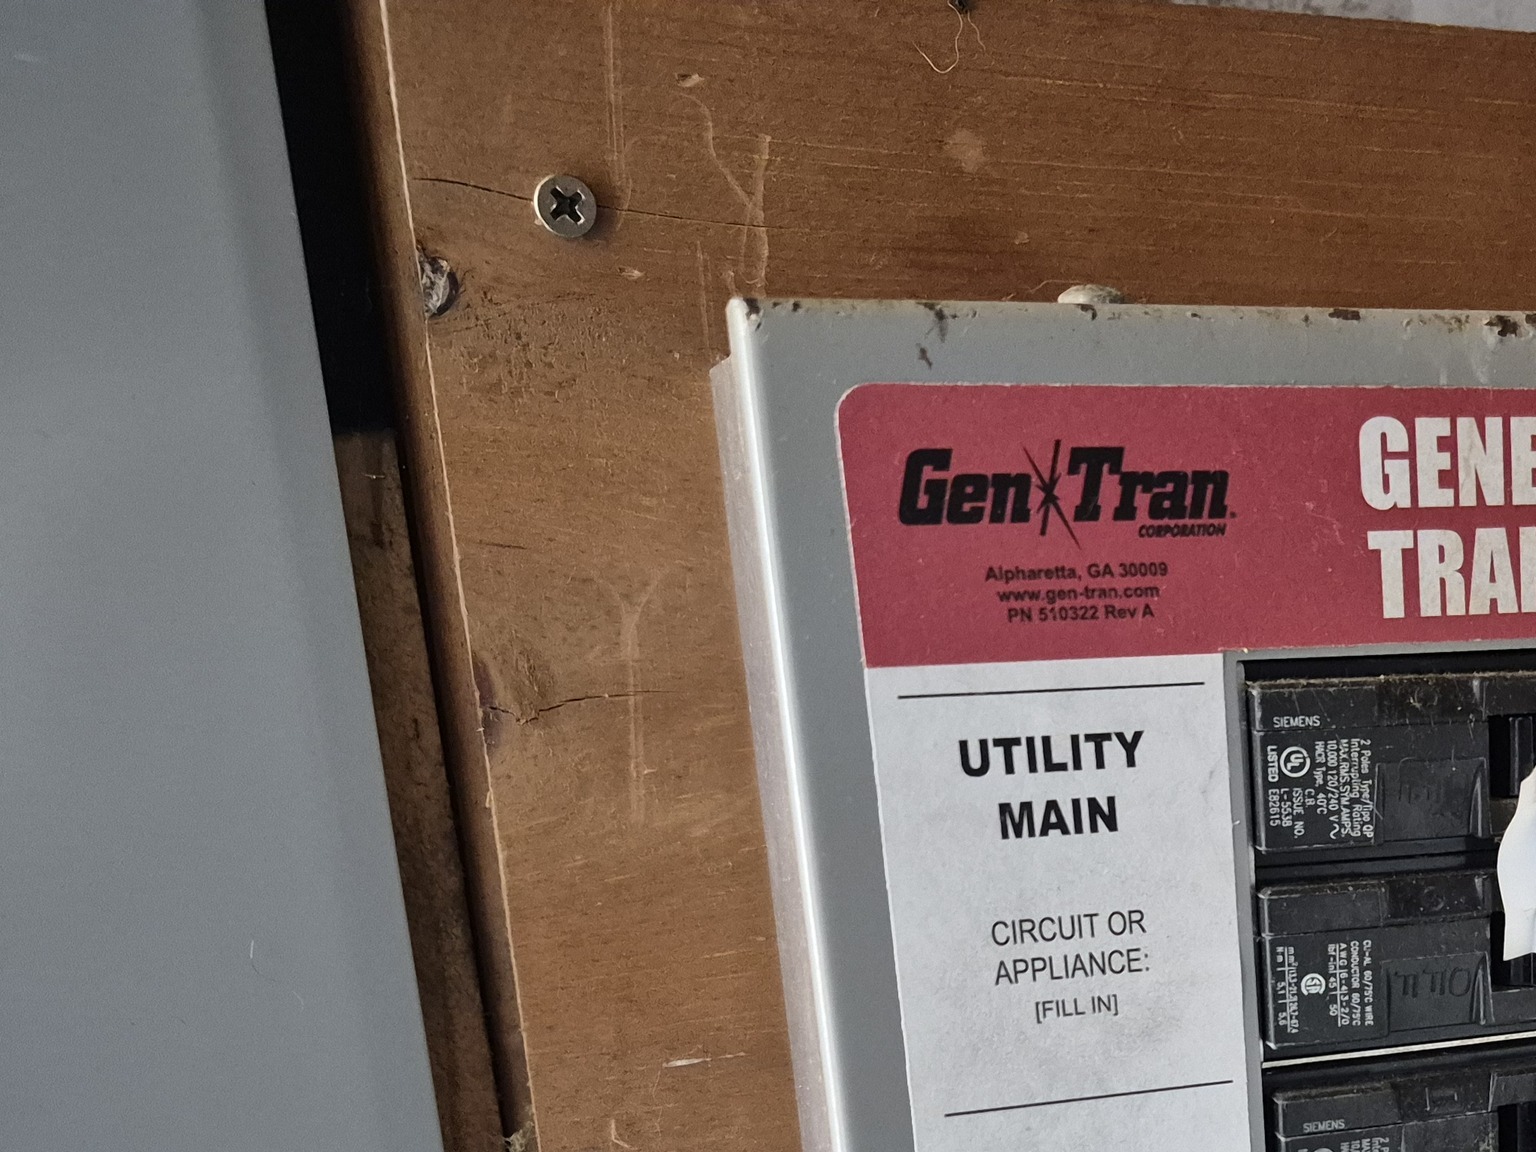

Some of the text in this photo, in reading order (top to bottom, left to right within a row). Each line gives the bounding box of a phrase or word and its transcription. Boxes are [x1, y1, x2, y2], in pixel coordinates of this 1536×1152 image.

[1138, 523, 1227, 538] CORPORATION
[985, 562, 1168, 584] Alpharetta, GA 30009
[997, 584, 1160, 604] www.gen-tran.com
[1008, 605, 1154, 623] PN 510322 Rev A
[1272, 715, 1321, 728] SIEMENS
[958, 730, 1145, 777] UTILITY
[1267, 745, 1281, 827] LISTED E82615
[1326, 770, 1339, 811] 120/240
[998, 795, 1119, 840] MAIN
[991, 909, 1148, 946] CIRCUIT OR
[994, 947, 1150, 986] APPLIANCE:
[1035, 994, 1119, 1024] [FILL IN]
[1303, 1119, 1346, 1133] SIEMENS
